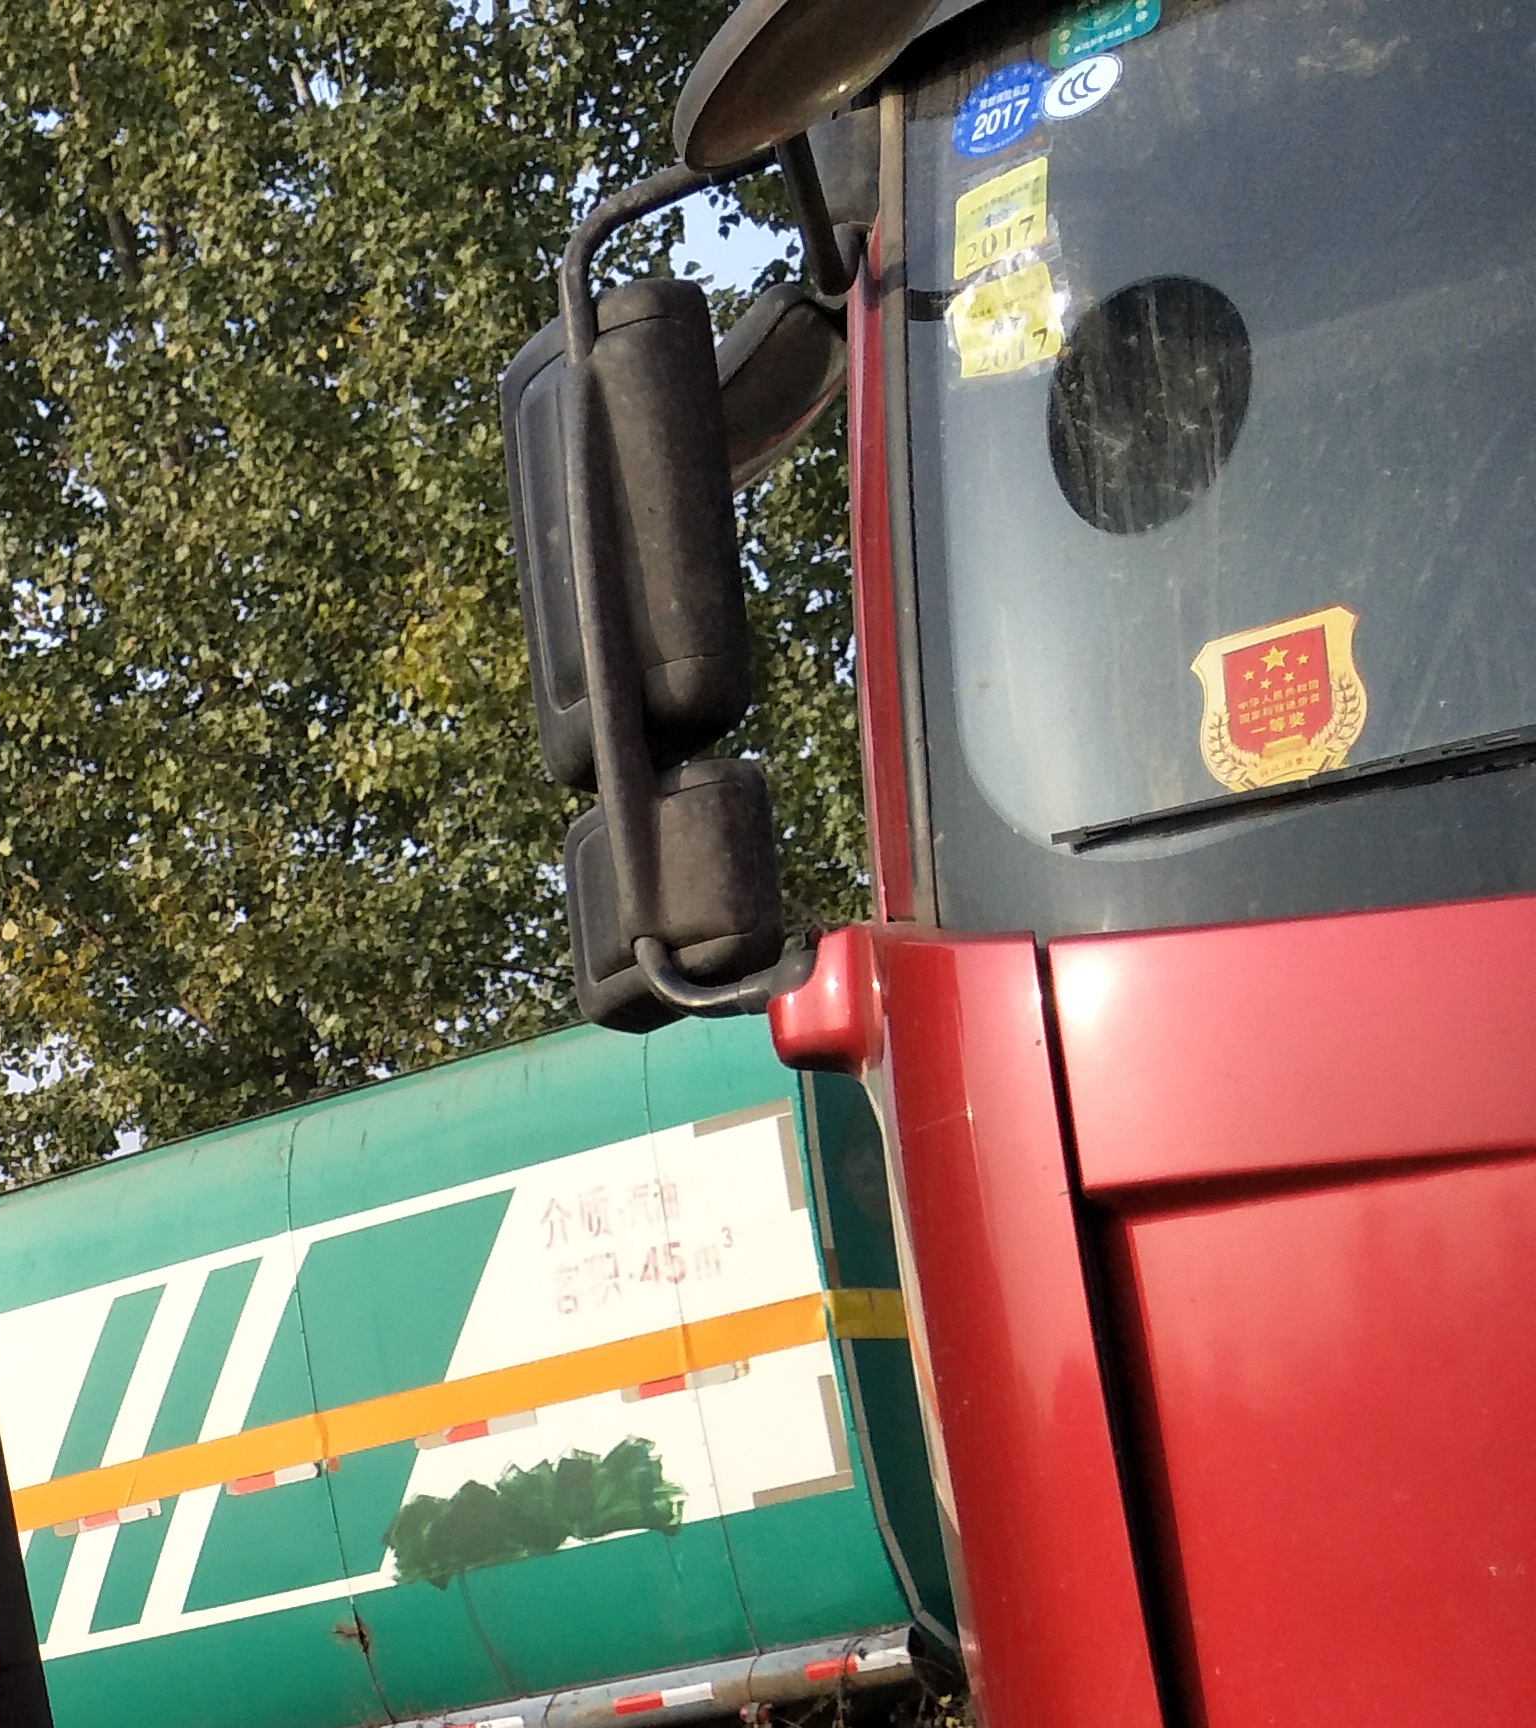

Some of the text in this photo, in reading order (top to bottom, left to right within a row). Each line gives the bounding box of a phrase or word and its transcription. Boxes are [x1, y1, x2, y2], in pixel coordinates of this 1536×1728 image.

[1058, 64, 1101, 106] CCC
[970, 98, 1031, 143] 2017
[965, 214, 1035, 269] 2017
[1250, 711, 1305, 734] 一等奖
